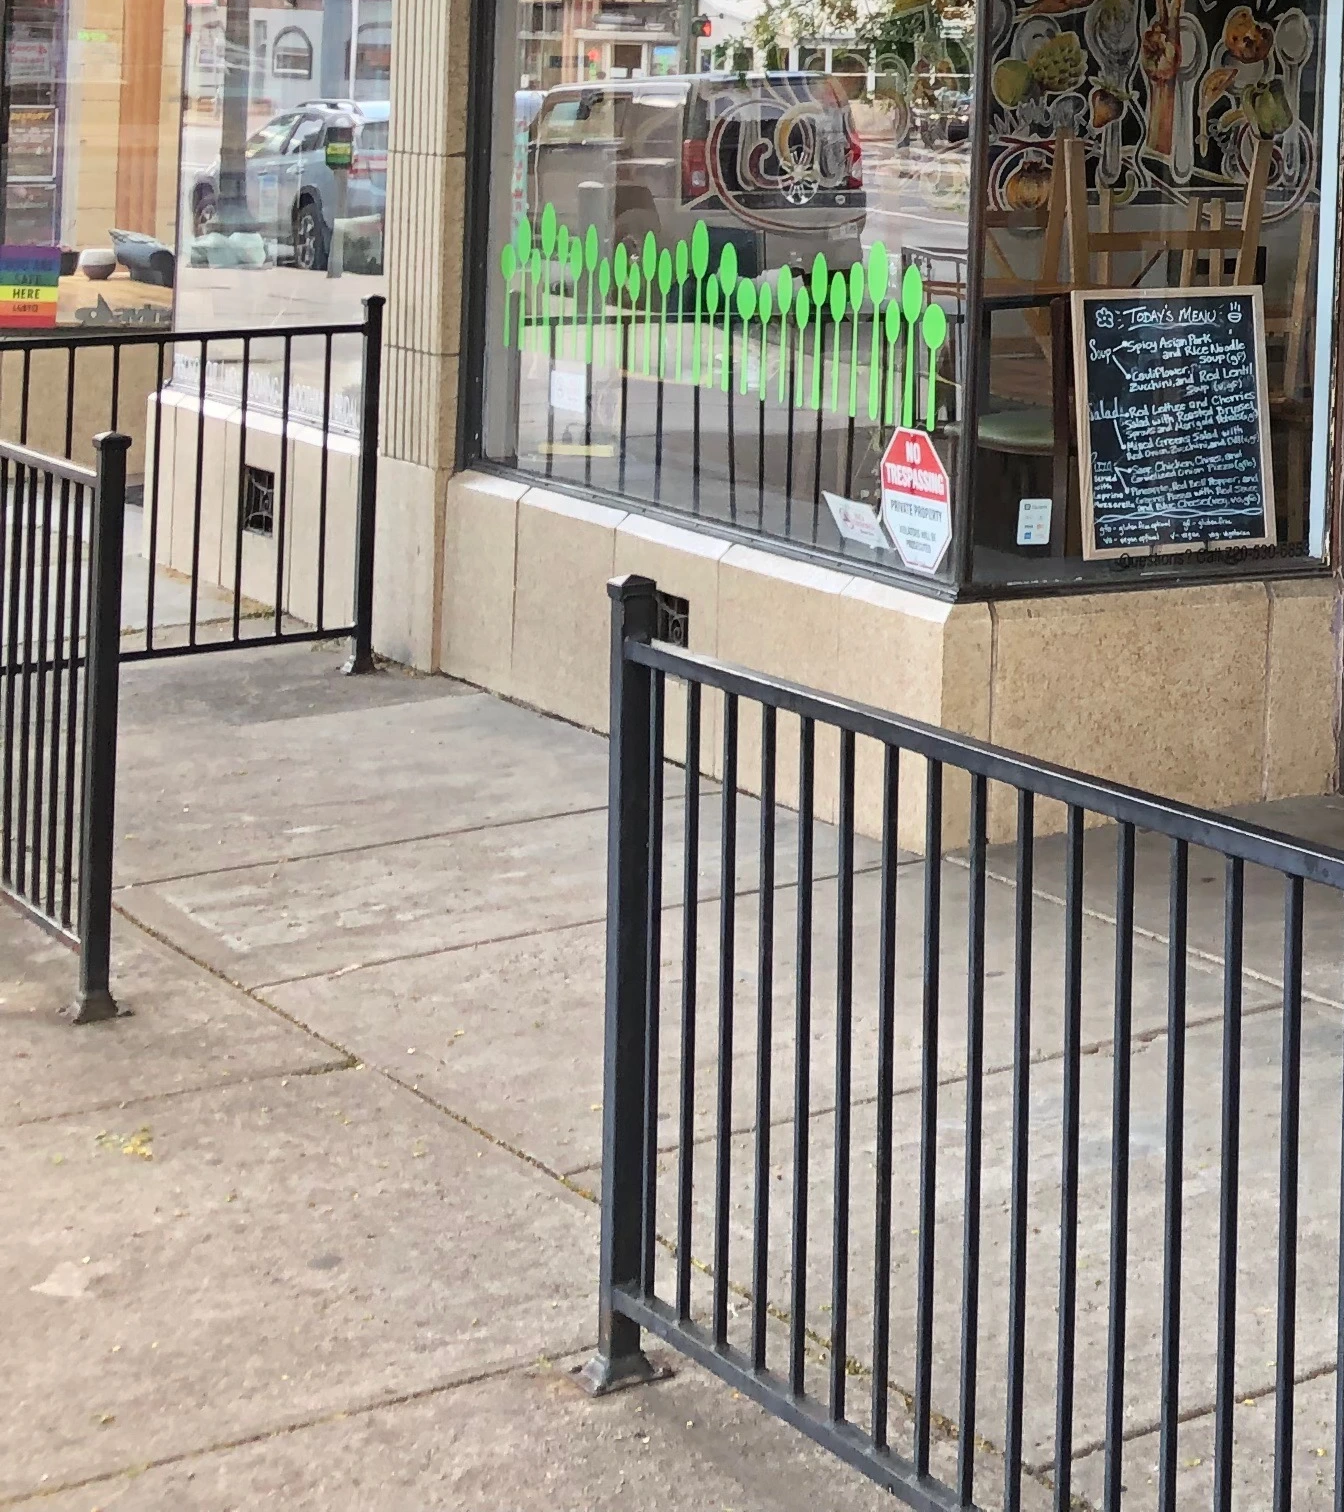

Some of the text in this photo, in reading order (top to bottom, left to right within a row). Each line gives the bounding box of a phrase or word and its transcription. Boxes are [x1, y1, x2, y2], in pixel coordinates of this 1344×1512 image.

[12, 287, 41, 300] HERE
[1122, 304, 1217, 324] TODAY'S MENU
[1089, 338, 1112, 364] Soup
[1127, 339, 1158, 355] Spicy
[1159, 336, 1188, 349] Asian
[1162, 338, 1246, 361] and Rice Noodle
[1200, 369, 1221, 383] Red
[1221, 362, 1253, 378] Lentil
[1128, 391, 1256, 419] Red Lettuce and Cherries
[1125, 416, 1150, 430] Salad
[1151, 412, 1175, 426] with
[1176, 405, 1214, 422] Roasted
[1156, 421, 1173, 434] and
[1174, 414, 1214, 432] Marigold
[1126, 424, 1244, 452] Mixed Greens Salad with
[904, 440, 922, 465] NO
[1126, 450, 1145, 462] Red
[1224, 448, 1243, 461] and
[884, 462, 945, 496] TRESPASSING
[1177, 466, 1205, 478] Onion
[1206, 462, 1235, 473] Pizza
[1094, 482, 1113, 491] with
[1171, 479, 1188, 492] Red
[1241, 472, 1259, 483] and
[1193, 486, 1215, 497] with
[1215, 484, 1233, 496] Red
[890, 499, 943, 523] PRIVATE PROPERTY
[1137, 501, 1154, 513] and
